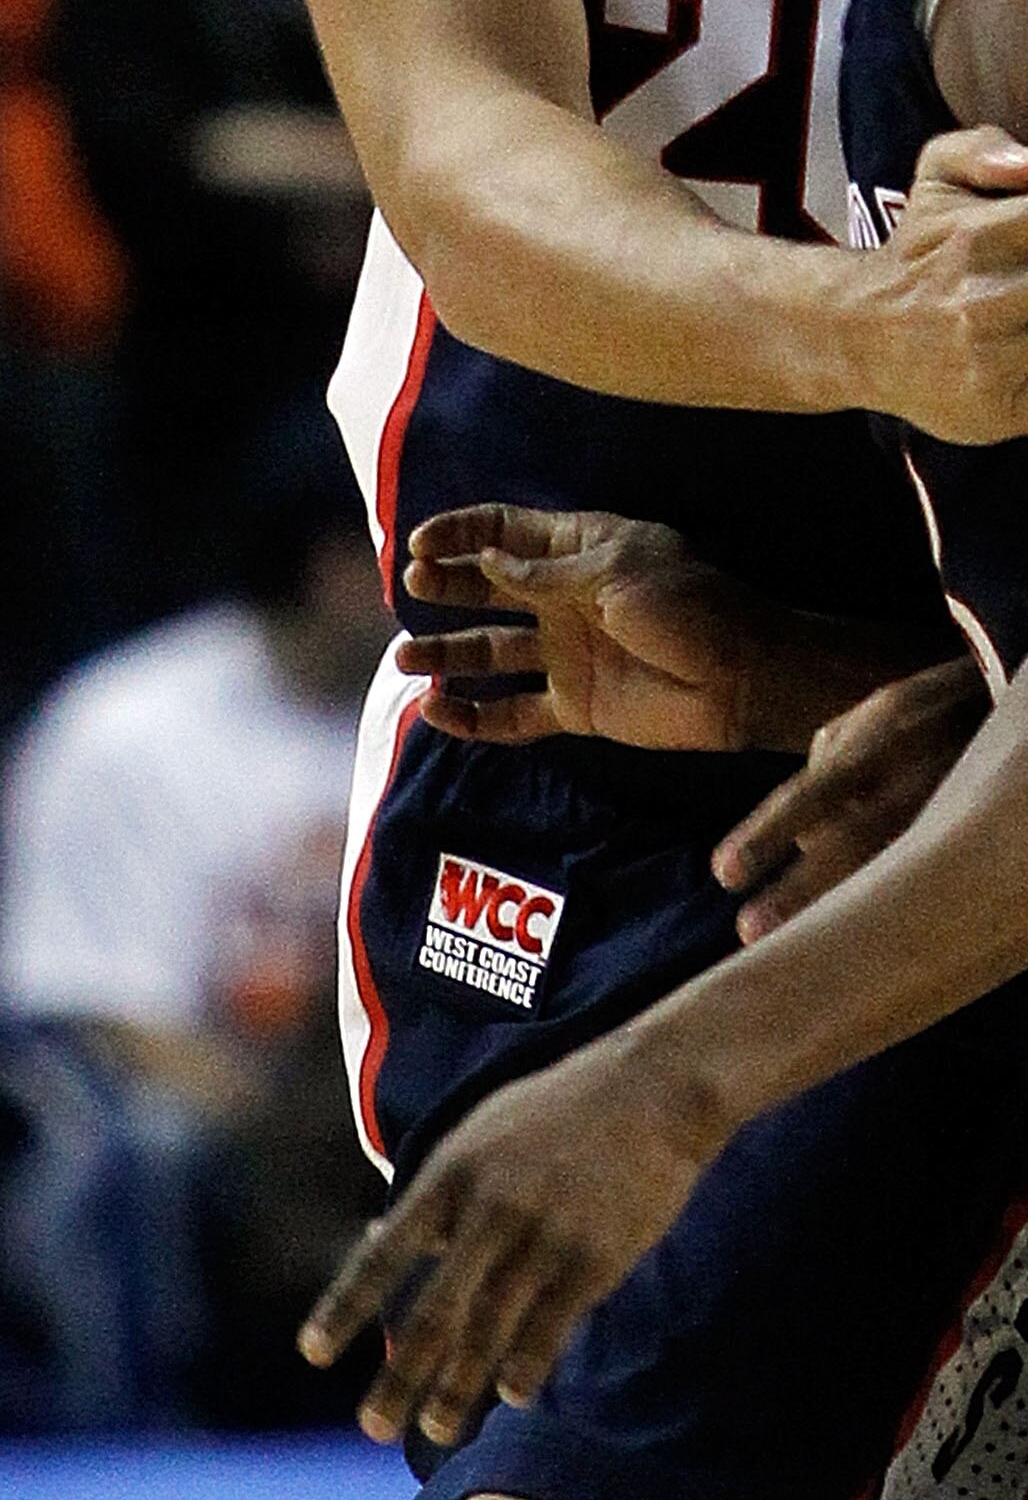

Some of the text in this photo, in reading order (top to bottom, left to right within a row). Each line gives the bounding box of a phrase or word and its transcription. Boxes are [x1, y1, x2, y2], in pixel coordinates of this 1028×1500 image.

[440, 859, 556, 954] WCC
[418, 945, 536, 1009] CONFERENCE
[425, 924, 542, 988] WEST COAST
